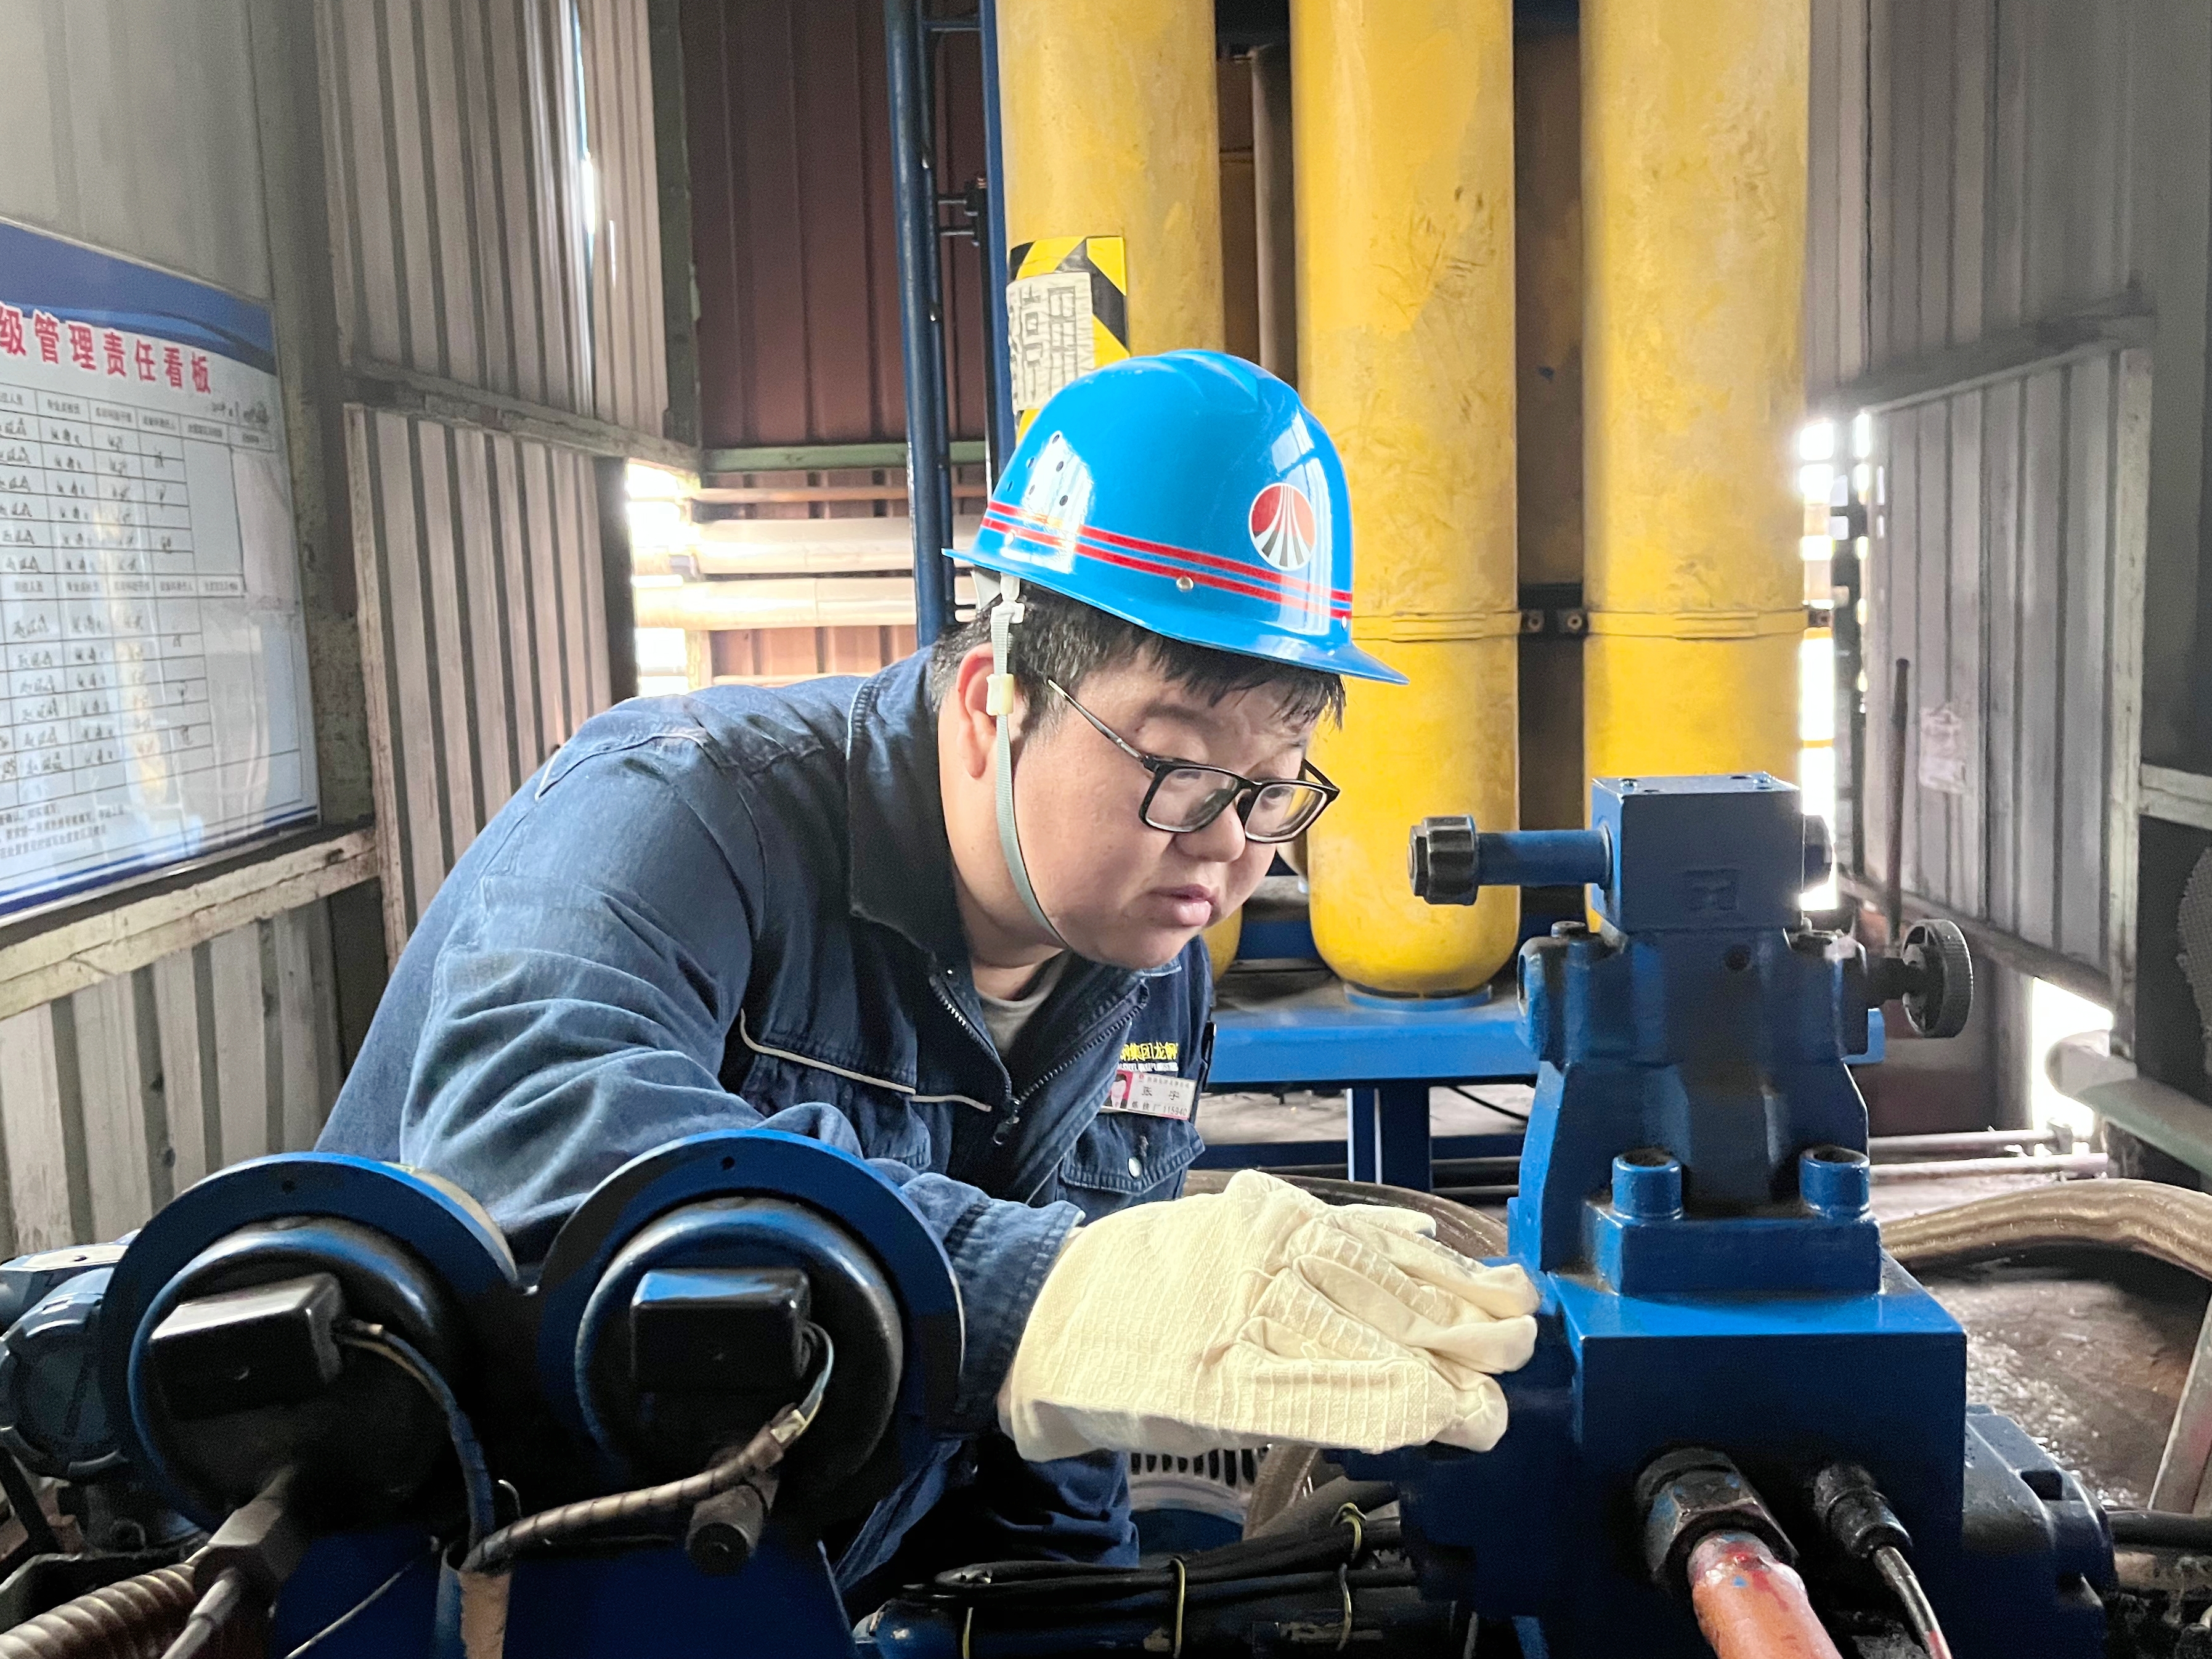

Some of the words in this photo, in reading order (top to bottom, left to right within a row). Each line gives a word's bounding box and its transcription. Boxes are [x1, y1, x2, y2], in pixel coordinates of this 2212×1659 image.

[0, 305, 211, 394] 级管理责任看板
